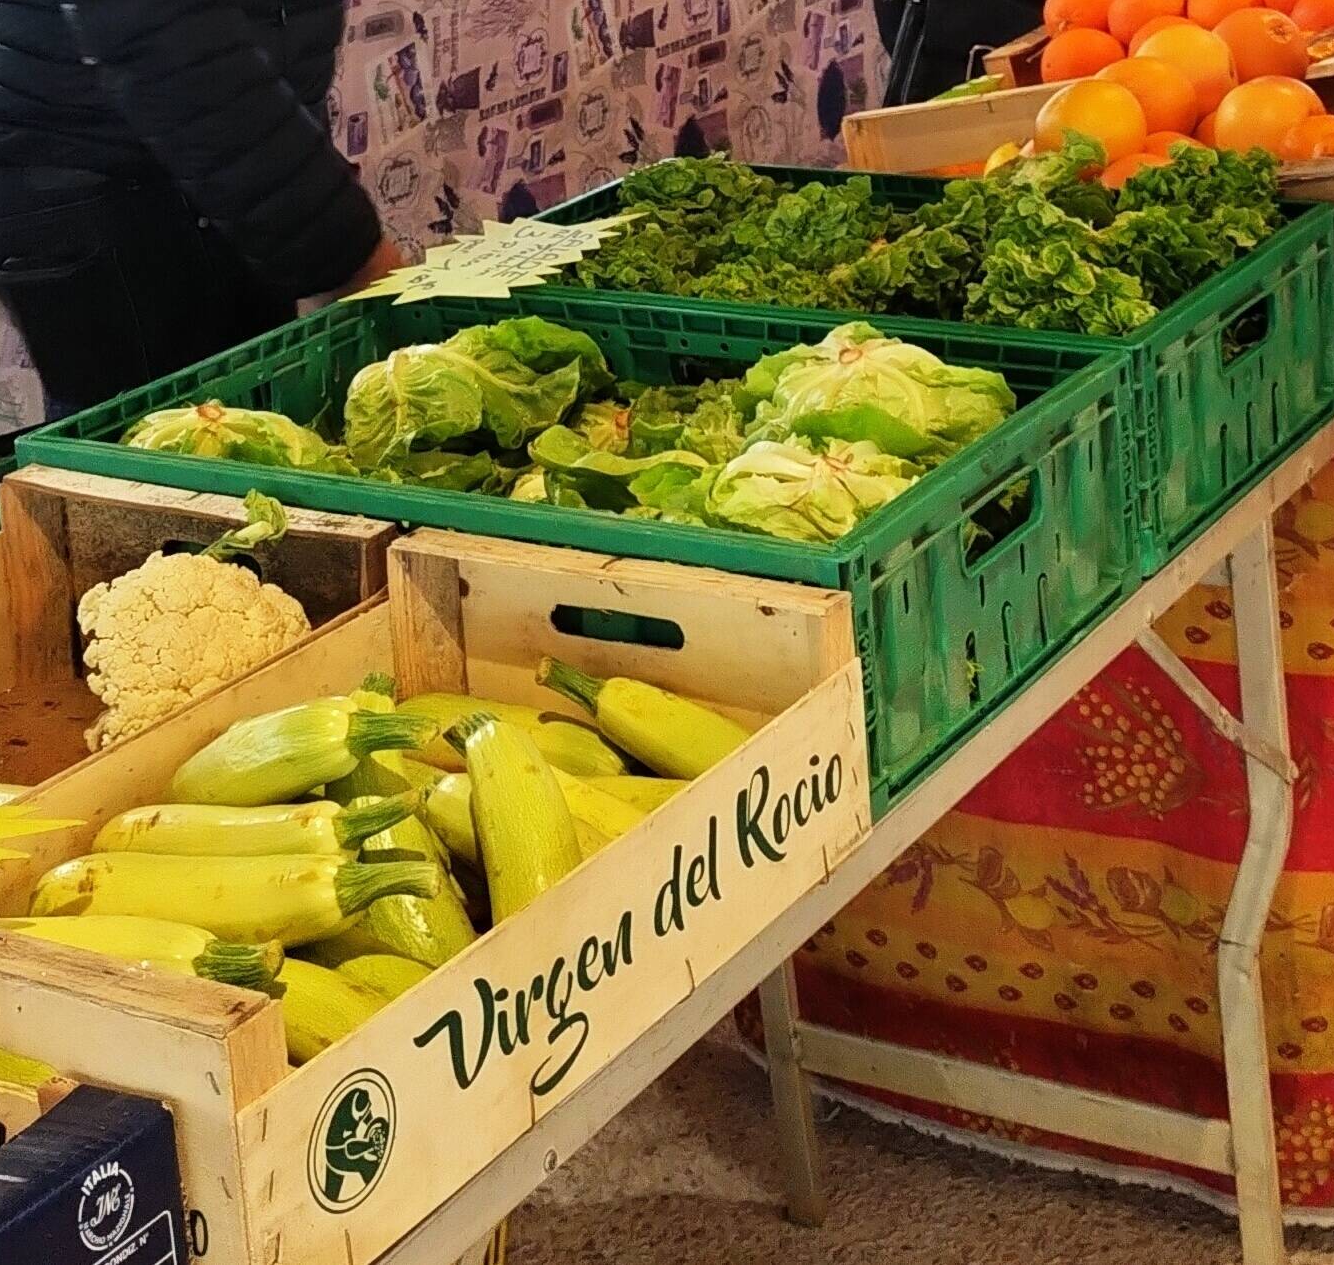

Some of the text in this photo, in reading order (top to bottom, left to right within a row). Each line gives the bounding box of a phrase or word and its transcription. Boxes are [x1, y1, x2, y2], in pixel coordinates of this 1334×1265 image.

[493, 232, 593, 284] SALADE
[413, 753, 843, 1097] Virgen del Rocio
[81, 1161, 120, 1197] ITALIA
